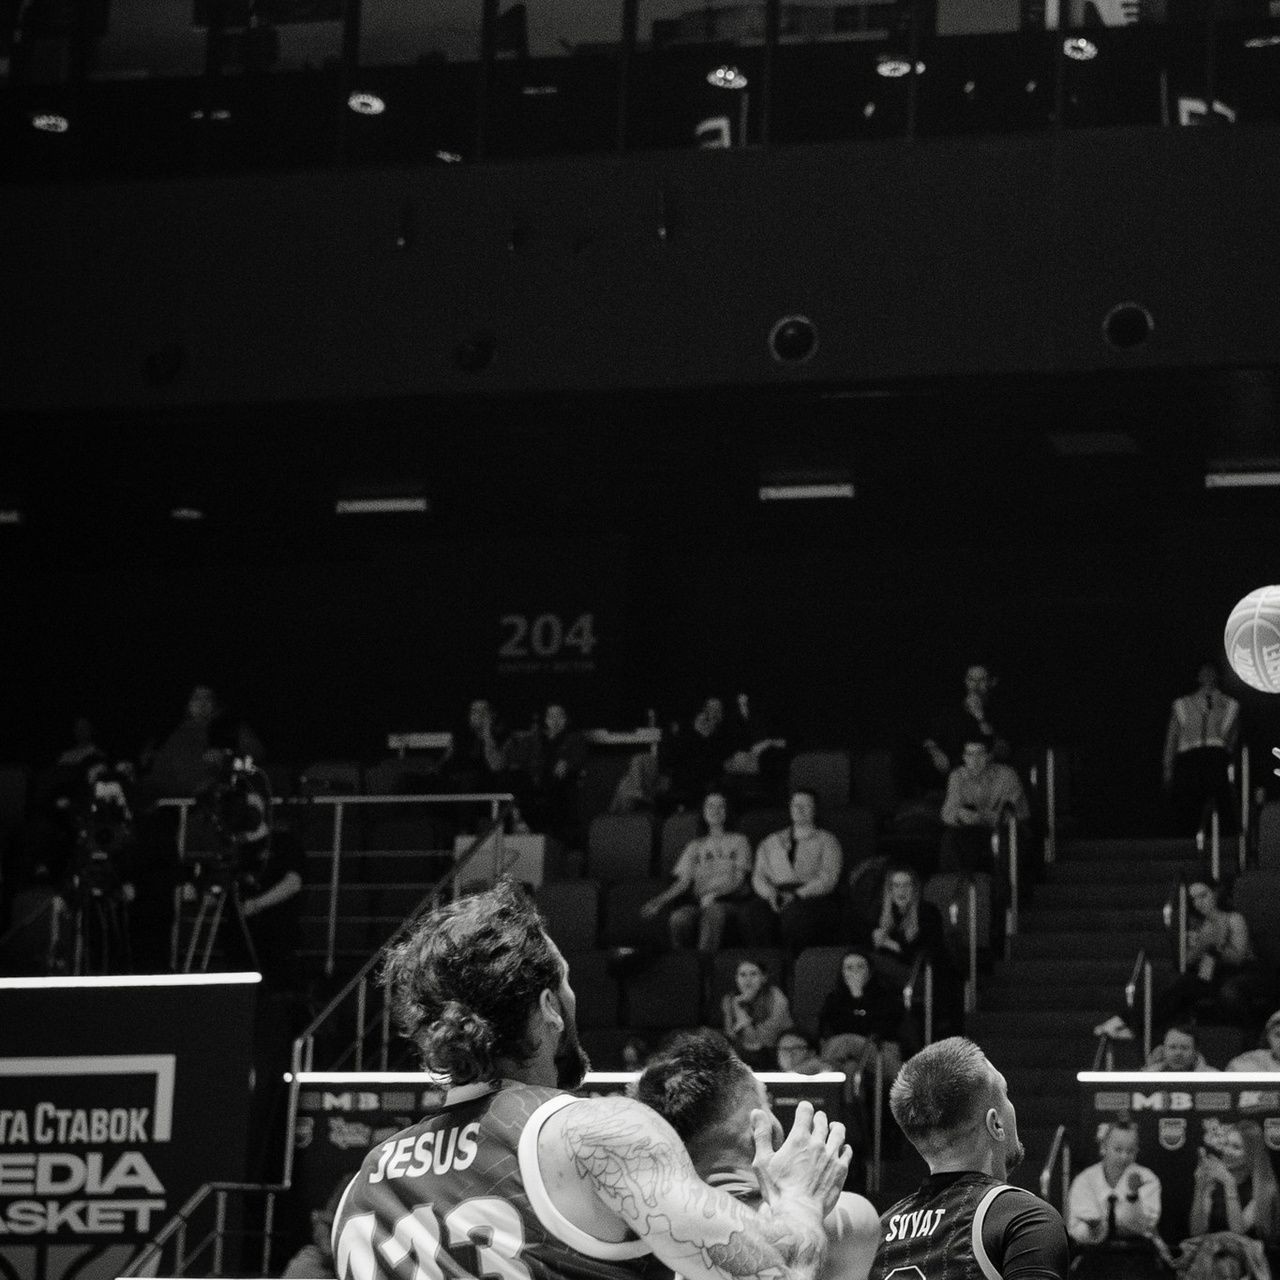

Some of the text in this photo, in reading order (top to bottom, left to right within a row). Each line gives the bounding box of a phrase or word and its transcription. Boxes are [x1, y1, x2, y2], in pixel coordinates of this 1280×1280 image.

[500, 613, 597, 656] 204
[369, 1122, 480, 1184] JESUS
[0, 1199, 167, 1235] SKET
[885, 1209, 946, 1242] SVYAT
